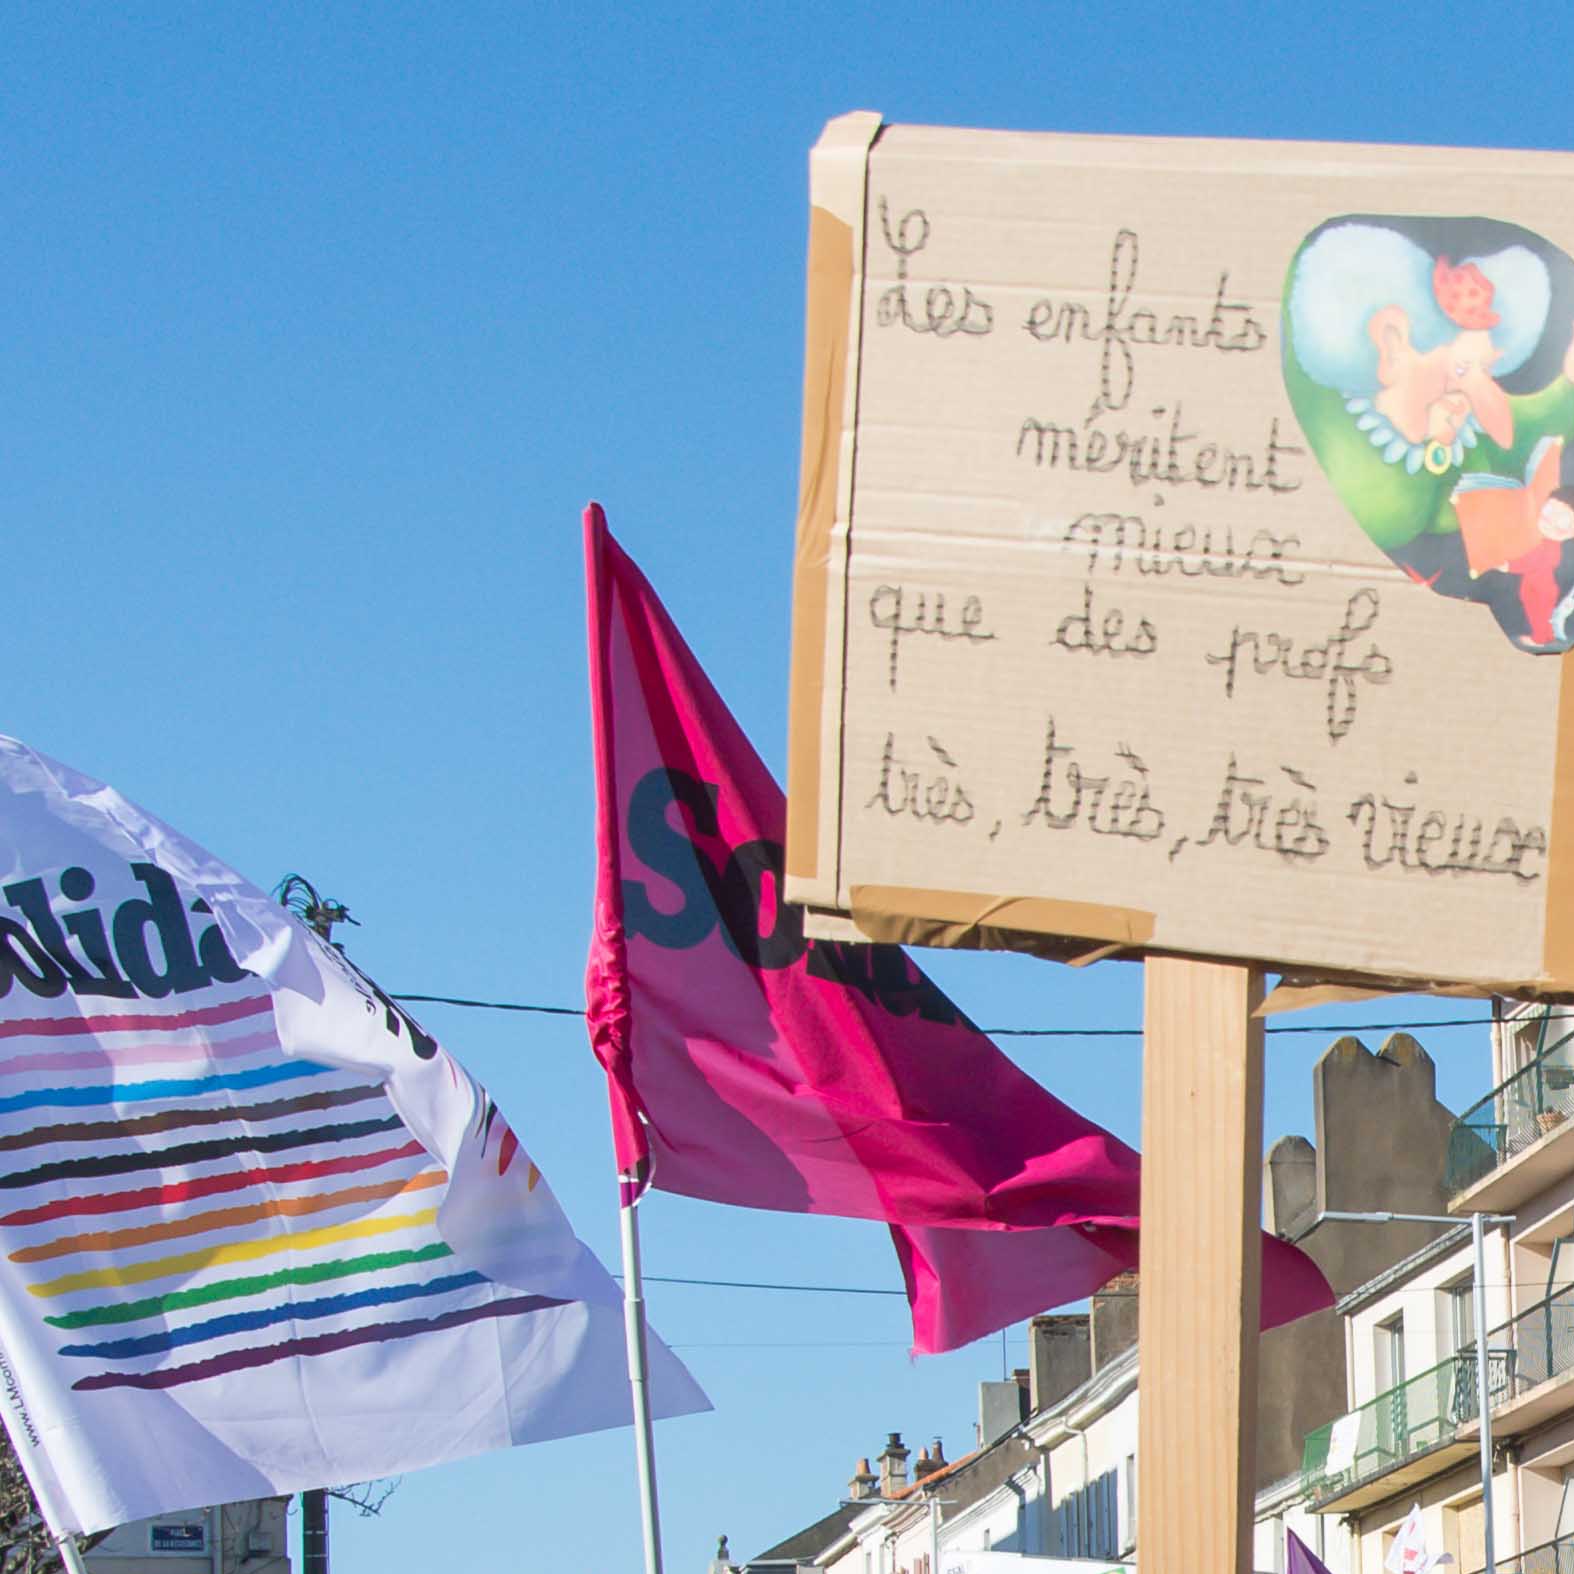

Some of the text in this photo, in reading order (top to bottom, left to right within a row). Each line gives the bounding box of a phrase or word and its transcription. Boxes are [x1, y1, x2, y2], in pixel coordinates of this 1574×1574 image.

[1023, 228, 1269, 411] enfants
[1016, 396, 1306, 492] méritent
[1061, 494, 1307, 586] mieux
[868, 583, 1394, 745] que des profs
[1196, 751, 1331, 860] très
[1346, 770, 1548, 883] vieux
